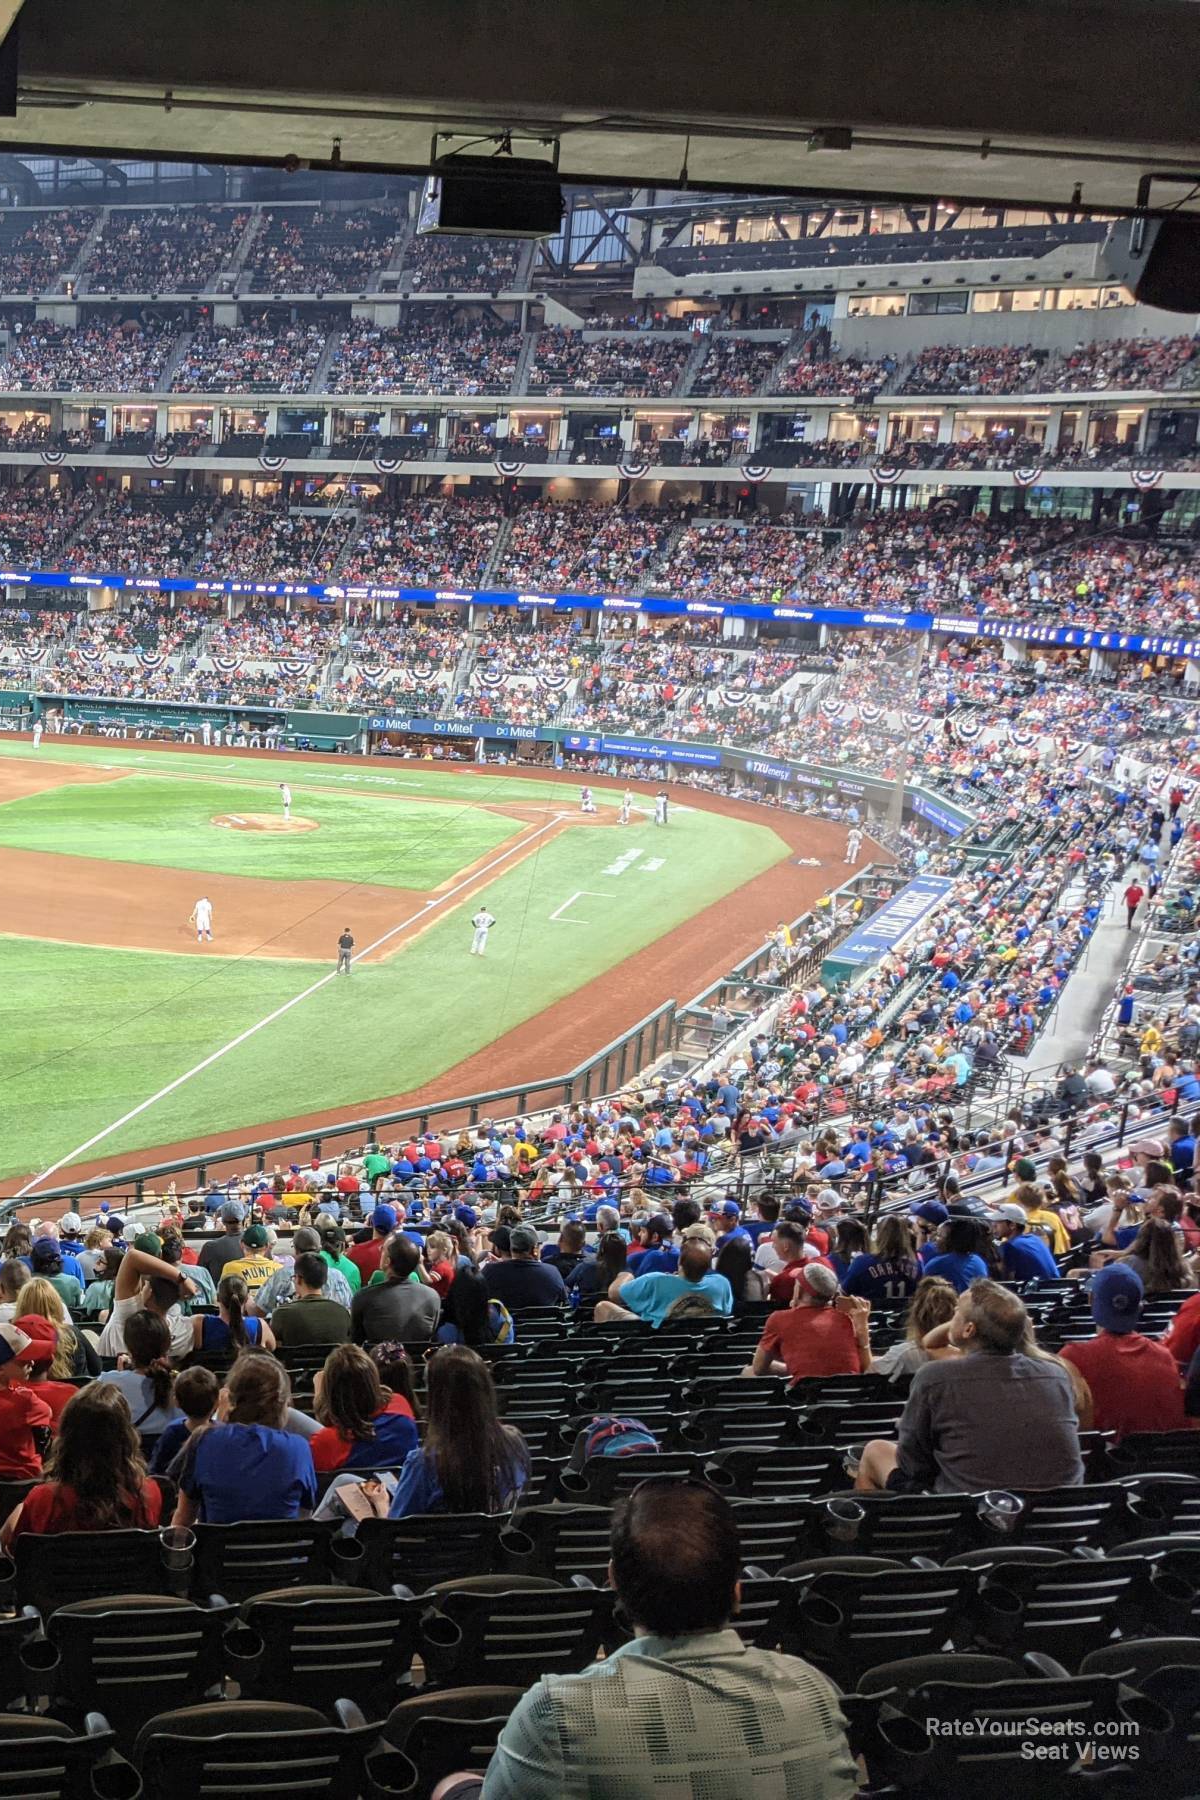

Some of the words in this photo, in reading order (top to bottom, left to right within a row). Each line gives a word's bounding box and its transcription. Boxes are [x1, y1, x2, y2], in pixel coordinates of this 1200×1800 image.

[386, 719, 411, 730] Mitel
[447, 723, 473, 734] Mitel
[510, 727, 536, 738] Mitel
[885, 890, 939, 918] RANGERS
[861, 915, 913, 938] TEXAS
[884, 1281, 906, 1298] 11
